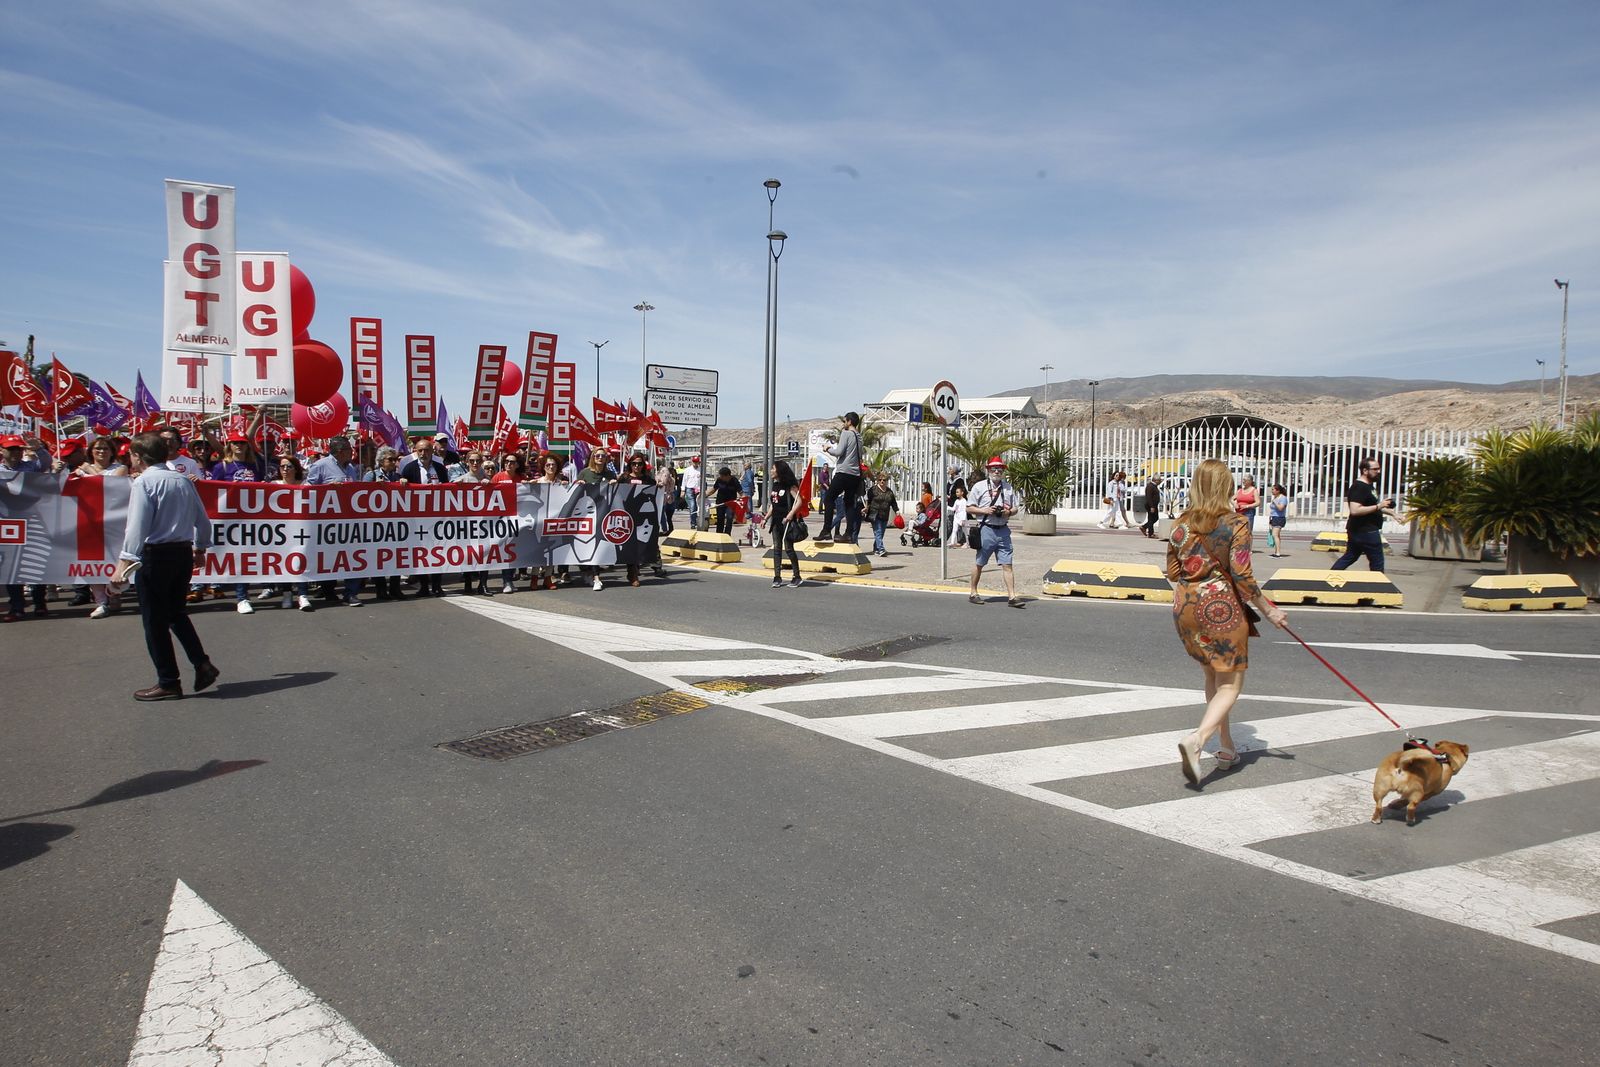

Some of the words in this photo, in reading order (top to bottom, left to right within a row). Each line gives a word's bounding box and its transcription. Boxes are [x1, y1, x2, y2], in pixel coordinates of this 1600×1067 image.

[181, 191, 221, 327] UGT
[241, 260, 278, 380] UGT
[175, 333, 230, 345] ALMERÍA
[410, 339, 432, 419] CCOO
[525, 335, 553, 414] CCOO
[238, 387, 288, 396] ALMERÍA
[474, 349, 502, 425] CCOO
[168, 395, 217, 406] ALMERÍA
[553, 366, 571, 439] CCOO
[653, 400, 676, 408] PUERTO
[687, 402, 711, 410] ALMERÍA
[678, 395, 702, 403] SERVICIO
[937, 394, 955, 411] 40
[913, 406, 920, 420] P
[217, 488, 342, 514] LUCHA
[350, 485, 506, 513] CONTINÚA
[61, 475, 105, 561] 1
[546, 521, 590, 533] CCOO
[606, 515, 630, 530] UGT
[213, 523, 287, 546] ECHOS
[317, 519, 409, 546] IGUALDAD
[433, 516, 520, 541] COHESIÓN
[67, 563, 116, 577] MAYO
[192, 552, 307, 576] MERO
[317, 548, 368, 574] LAS
[376, 543, 517, 570] PERSONAS
